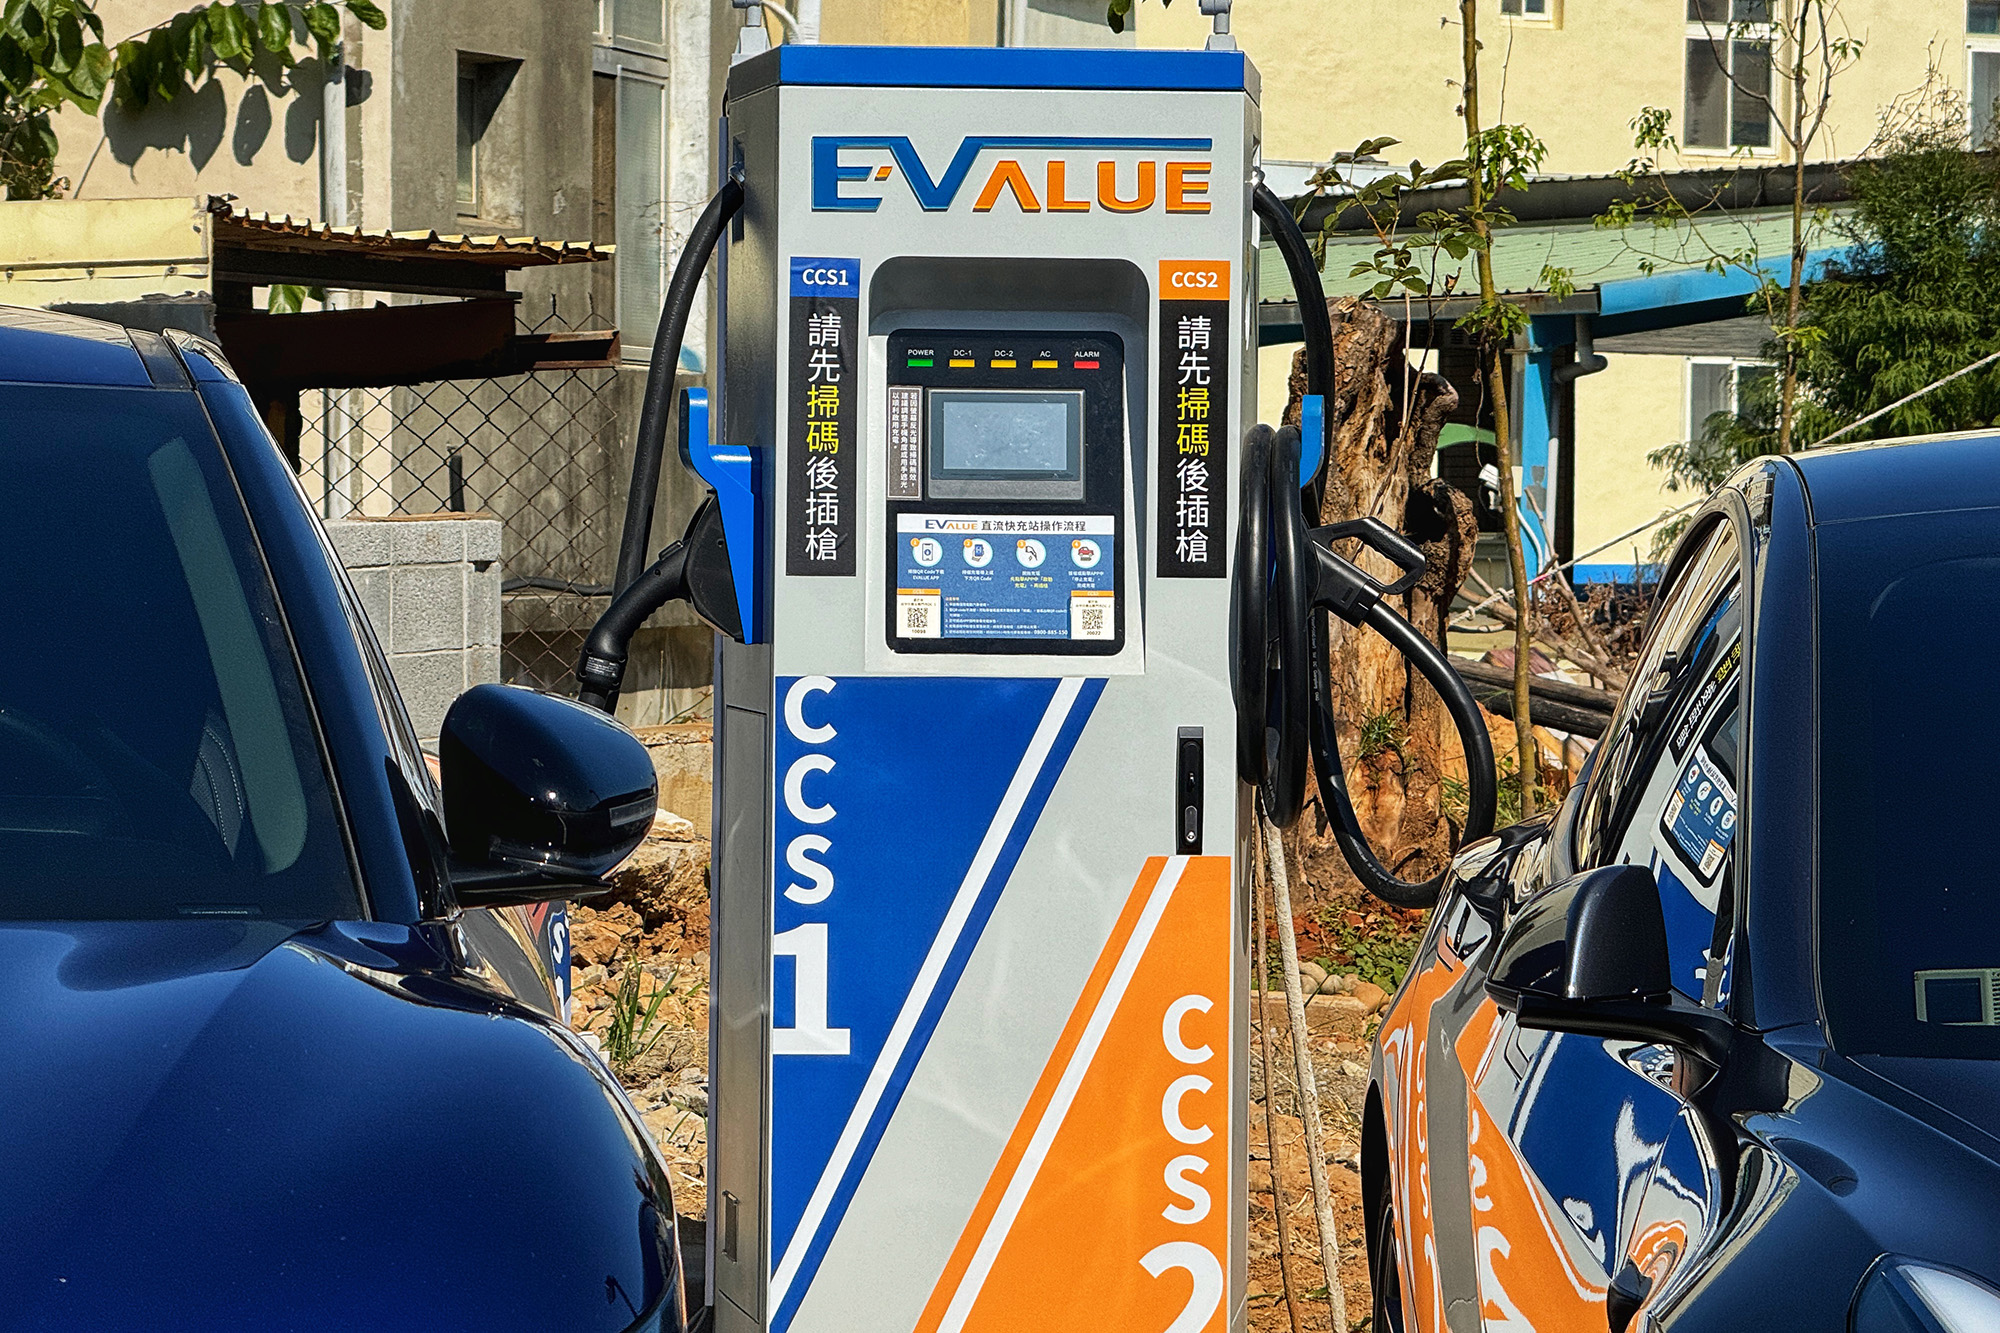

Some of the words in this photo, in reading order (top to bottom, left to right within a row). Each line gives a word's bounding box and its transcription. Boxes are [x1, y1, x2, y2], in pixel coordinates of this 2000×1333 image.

[811, 136, 1212, 214] EVALUE
[802, 268, 849, 286] CCS1
[1171, 271, 1218, 288] CCS2
[805, 313, 841, 561] 請先掃碼後插槍
[1176, 316, 1211, 563] 請先掃碼後插槍
[925, 519, 978, 530] EVALUE
[981, 520, 1087, 532] 直流快充站操作流程
